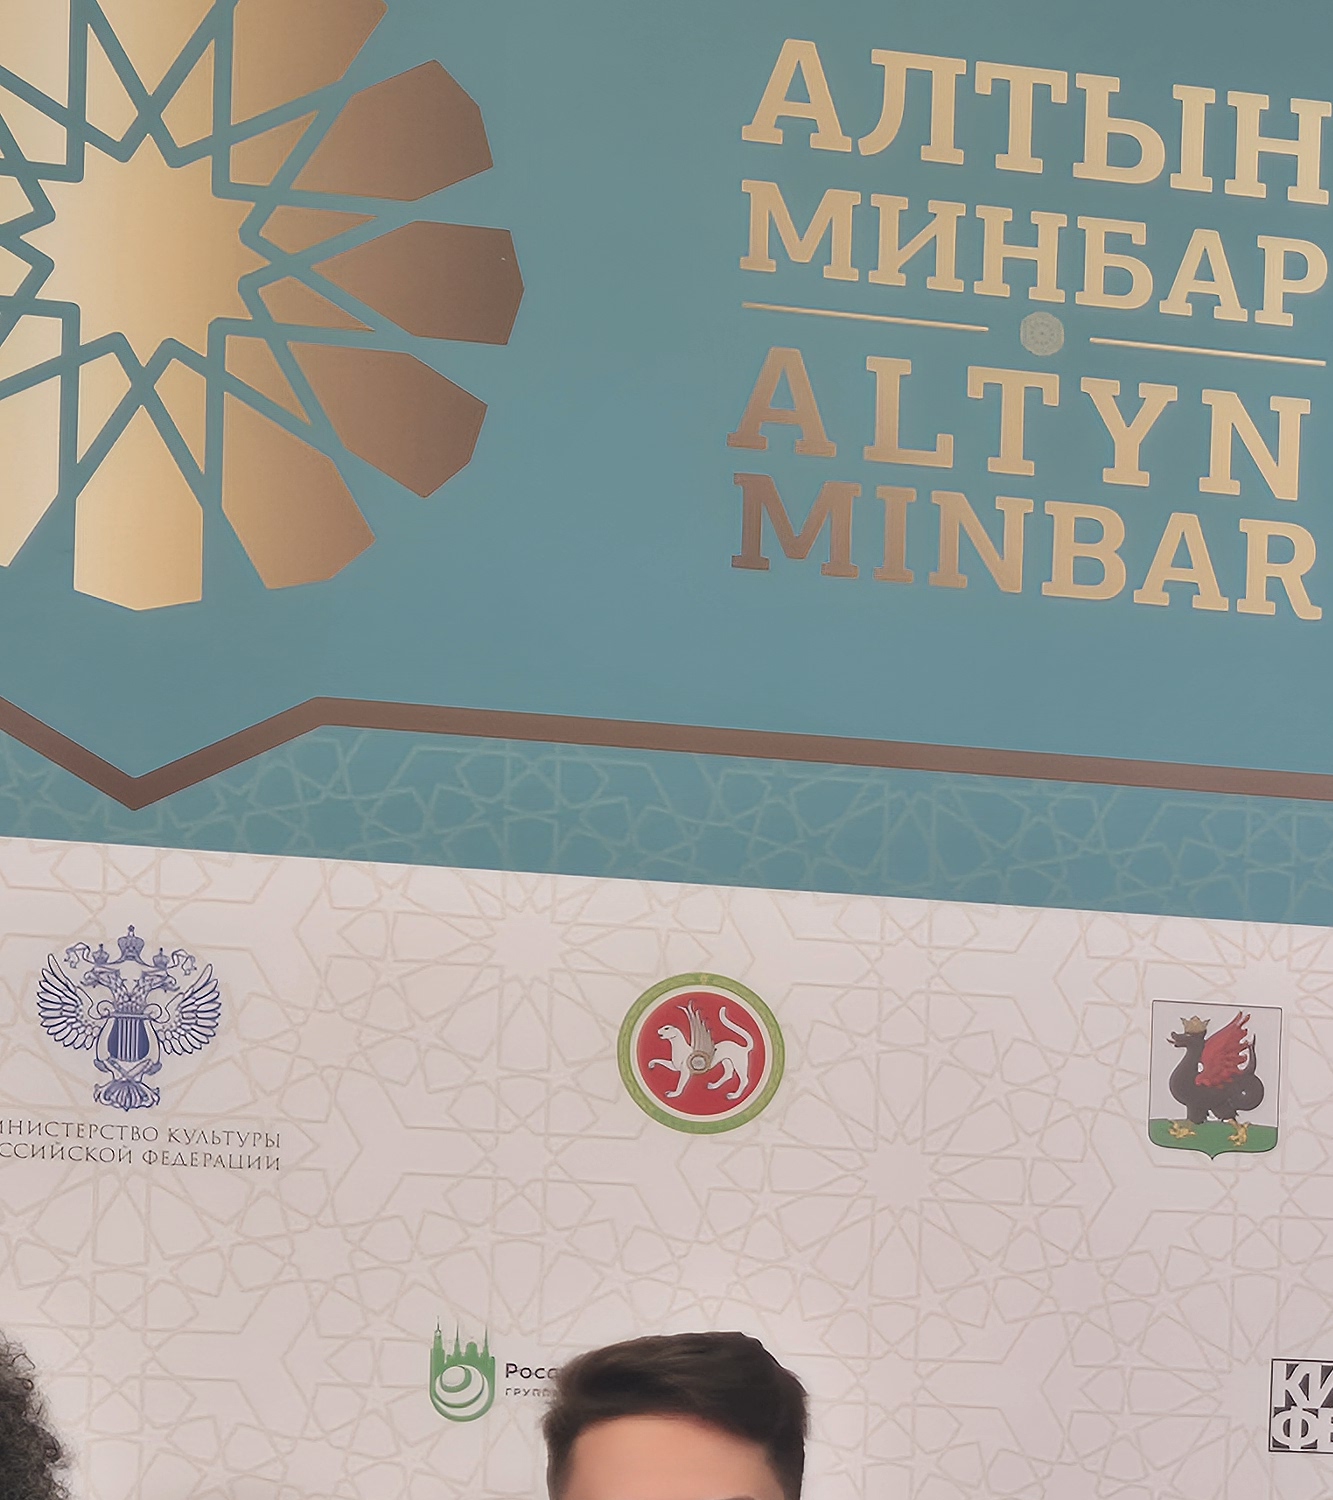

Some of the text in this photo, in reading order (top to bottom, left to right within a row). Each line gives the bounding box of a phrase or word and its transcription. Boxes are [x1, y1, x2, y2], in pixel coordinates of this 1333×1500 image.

[742, 38, 1332, 205] АЛТЫН
[739, 179, 1328, 326] МИНБАР
[726, 346, 1311, 501] ALTYN
[731, 472, 1322, 620] MINBAR
[142, 1150, 280, 1171] ФЕДЕРАЦИИ
[168, 1127, 281, 1148] КУЛЬТУРЫ
[505, 1363, 560, 1379] Росс
[505, 1388, 558, 1397] ГРУПП
